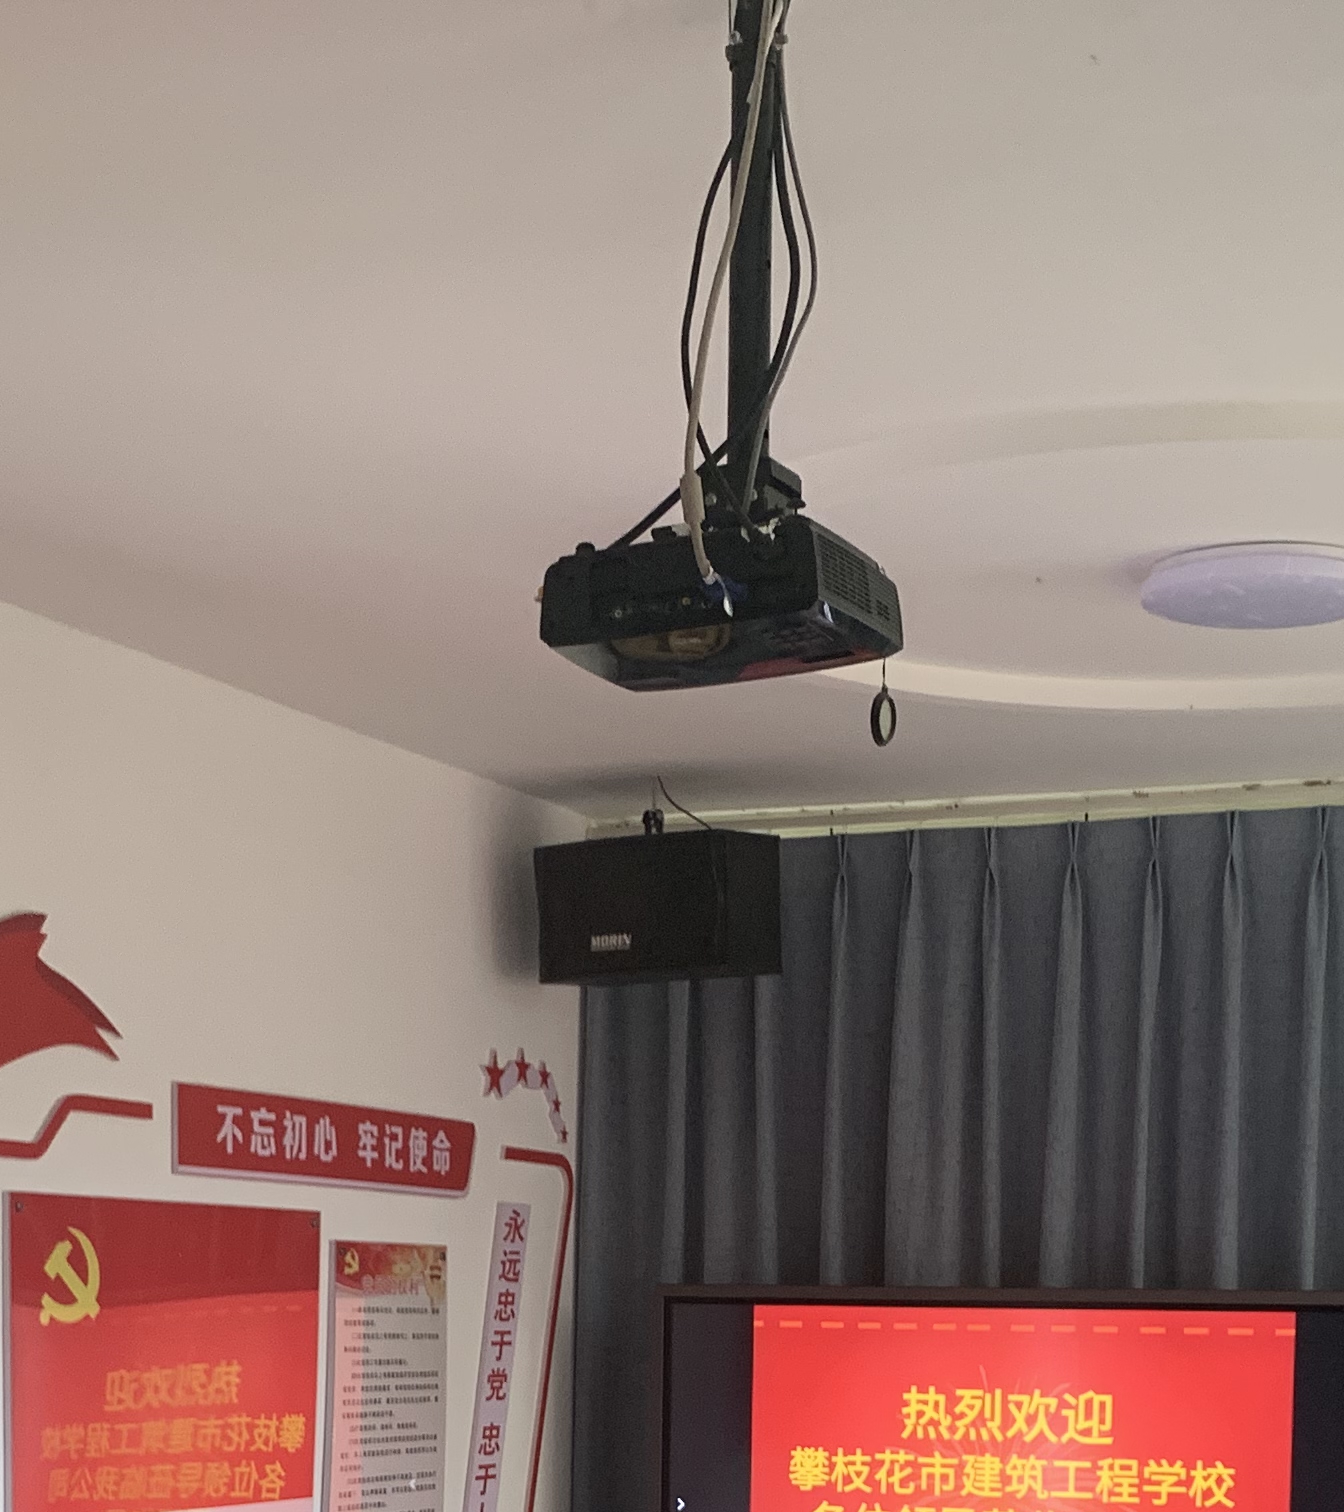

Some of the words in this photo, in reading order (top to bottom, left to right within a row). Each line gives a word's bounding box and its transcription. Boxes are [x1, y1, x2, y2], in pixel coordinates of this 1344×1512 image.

[216, 1104, 338, 1162] 不忘初心
[357, 1120, 452, 1175] 牢记使命
[485, 1209, 525, 1401] 永远忠于党
[900, 1385, 1115, 1445] 热烈欢迎
[788, 1446, 1236, 1509] 攀枝花市建筑工程学校
